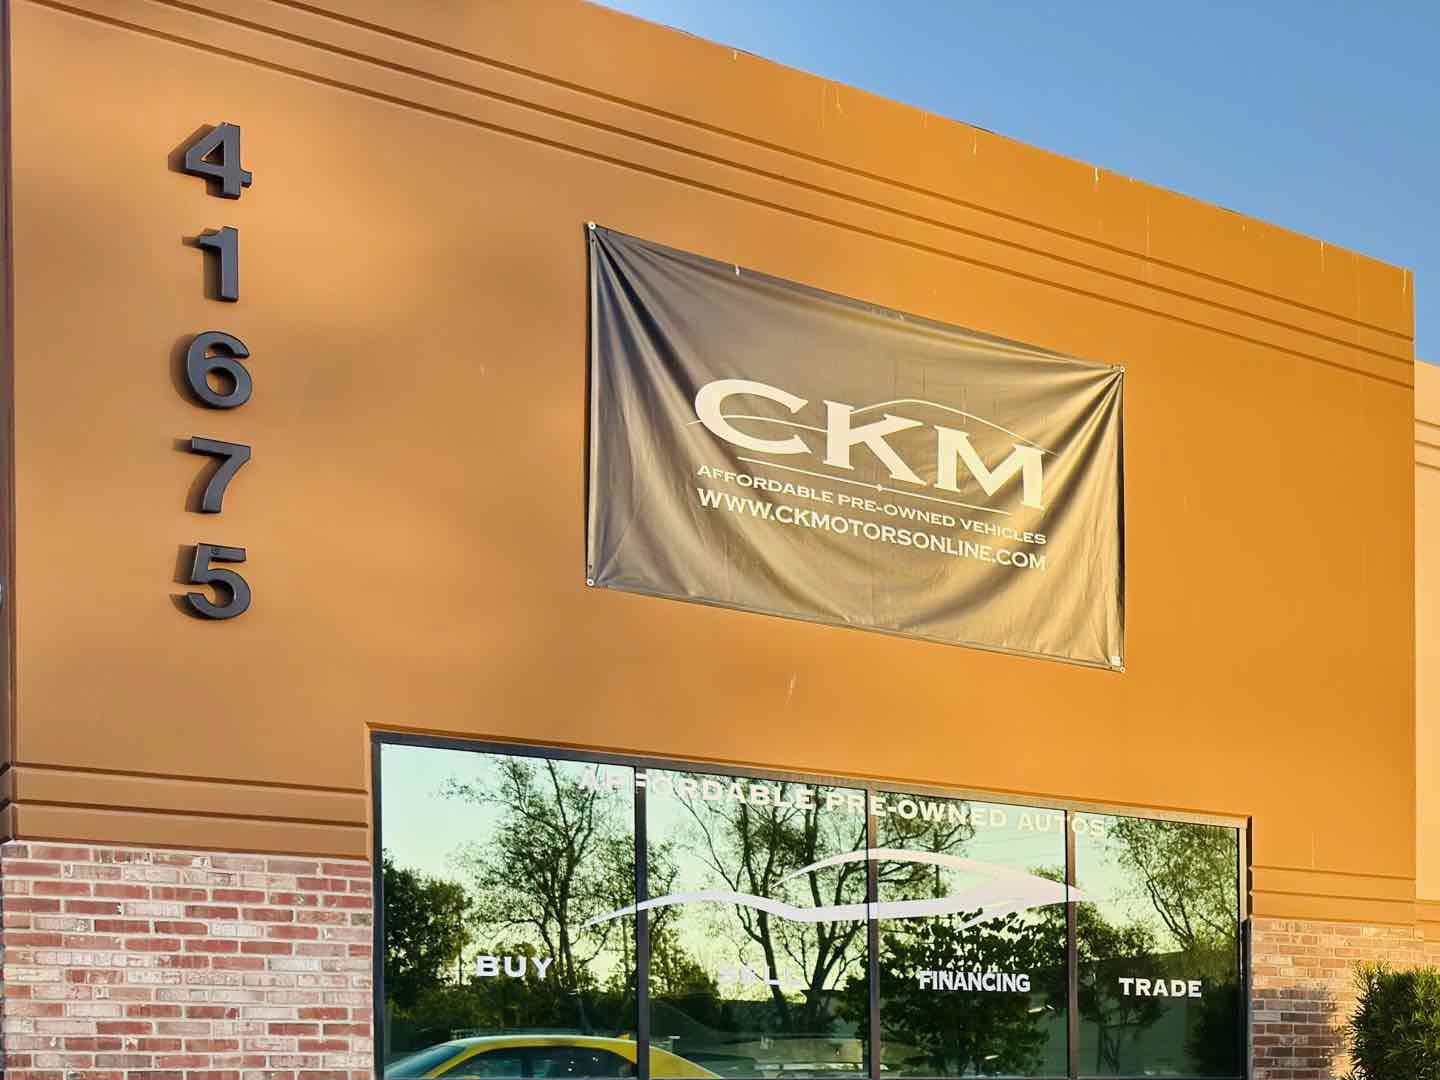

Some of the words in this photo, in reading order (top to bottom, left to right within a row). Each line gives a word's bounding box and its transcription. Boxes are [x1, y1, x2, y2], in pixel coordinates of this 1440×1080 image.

[178, 121, 252, 620] 41675
[694, 378, 1046, 510] CKM
[696, 487, 1046, 571] WWW.CKMOTORSONLINE.COM
[697, 464, 834, 504] AFFORDABLE
[838, 493, 956, 528] PRE-OWNED
[959, 517, 1047, 545] VEHICLES
[826, 788, 1006, 827] PRE-OWNED
[1017, 811, 1106, 838] AUTOS
[476, 955, 554, 979] BUY
[918, 969, 1031, 993] FINANCING
[1118, 977, 1203, 998] TRADE
